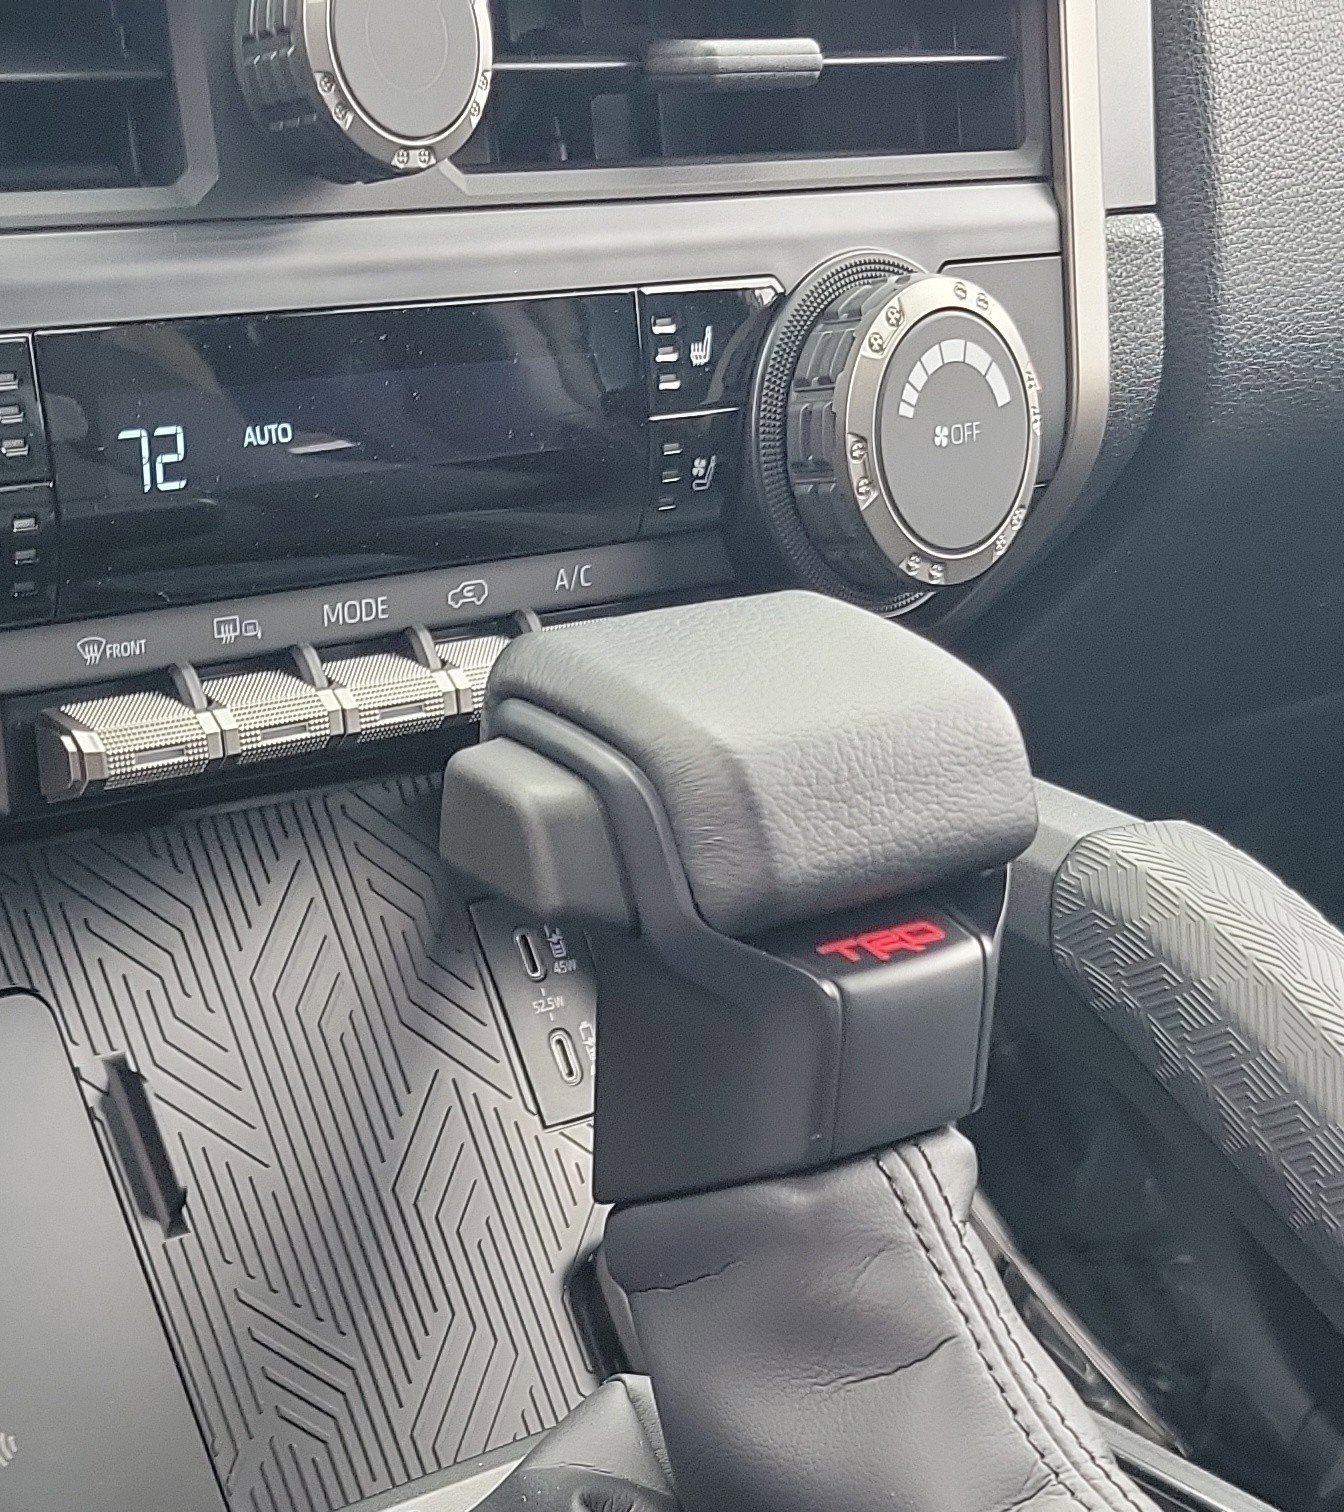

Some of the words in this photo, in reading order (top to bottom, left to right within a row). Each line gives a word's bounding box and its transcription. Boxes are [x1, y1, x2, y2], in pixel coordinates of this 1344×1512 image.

[243, 422, 293, 449] AUTO
[950, 420, 982, 447] OFF
[117, 425, 188, 494] 72
[554, 562, 594, 592] A/C
[322, 596, 390, 629] MODE
[105, 638, 147, 661] FRONT
[816, 919, 946, 963] TRD
[553, 958, 577, 975] 45W
